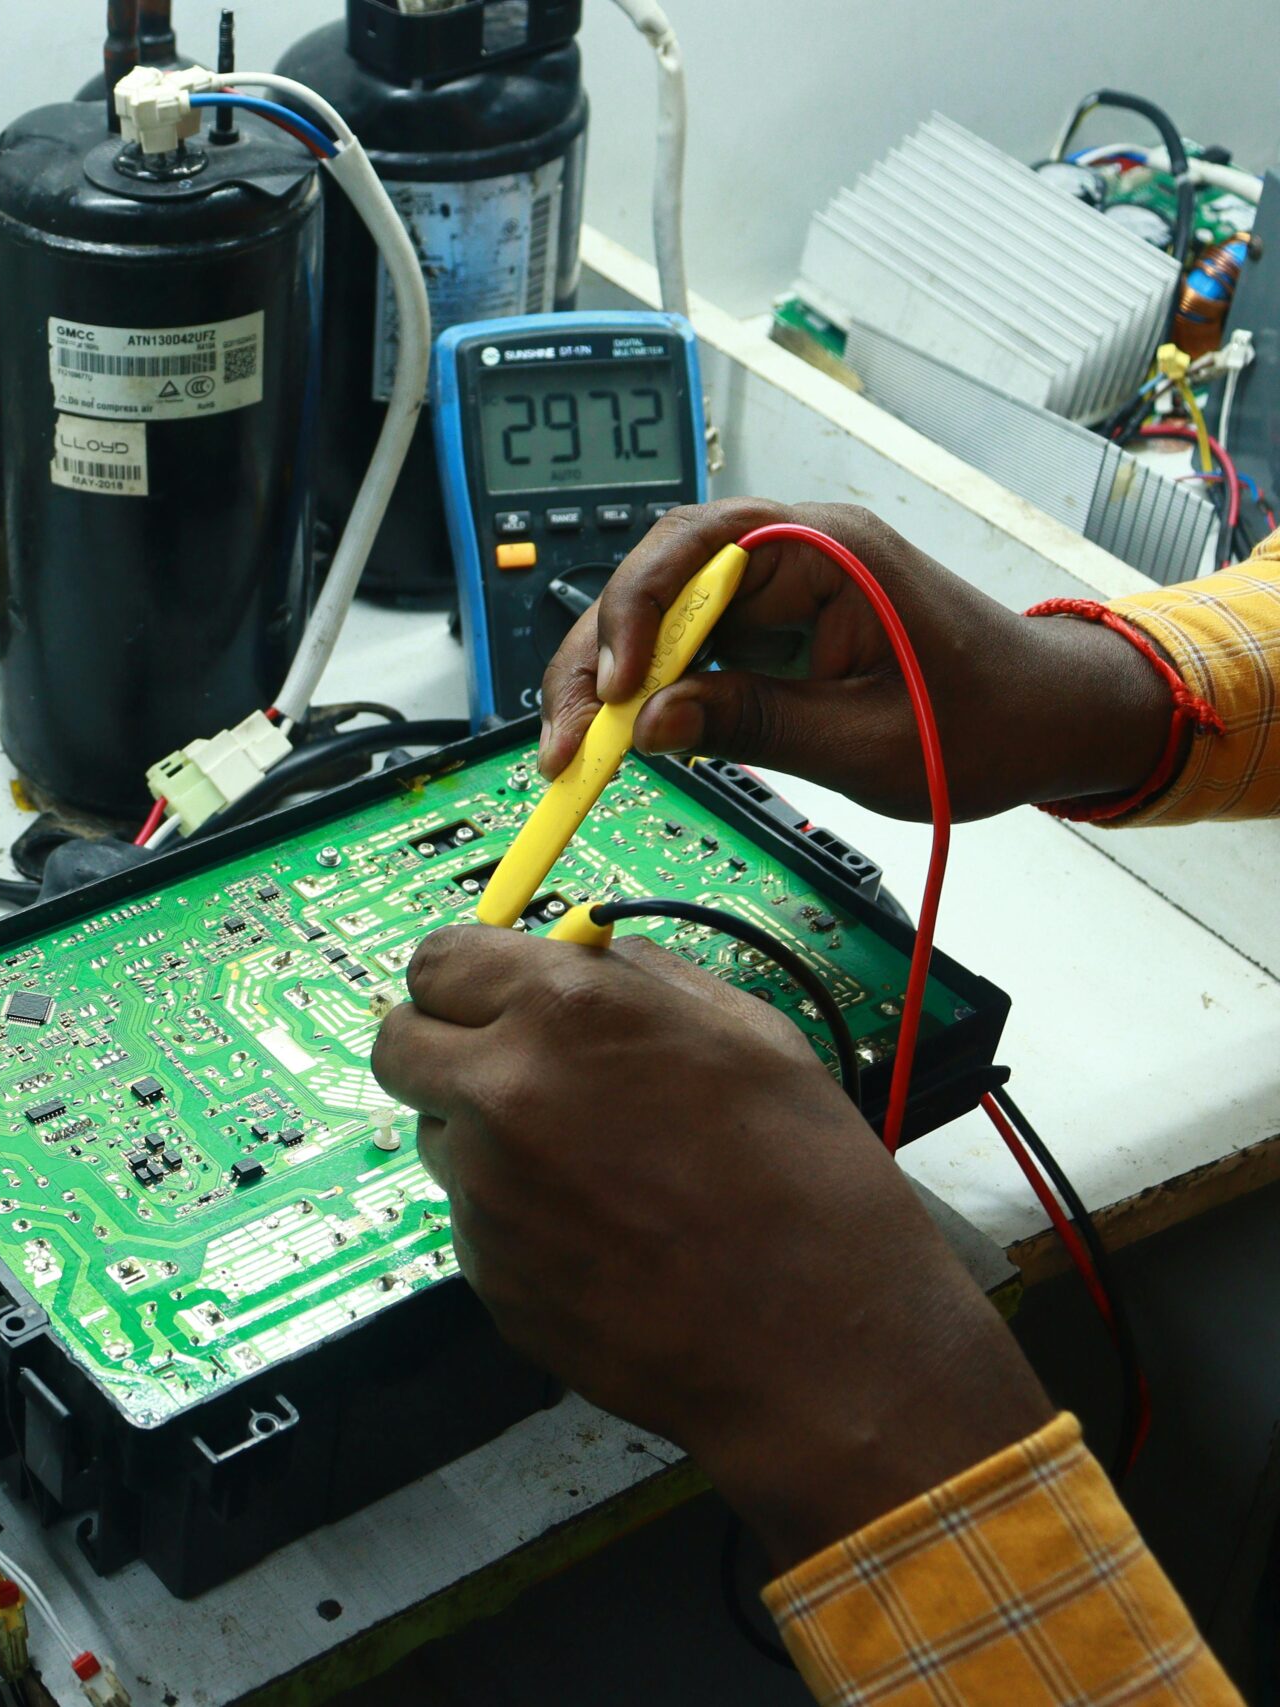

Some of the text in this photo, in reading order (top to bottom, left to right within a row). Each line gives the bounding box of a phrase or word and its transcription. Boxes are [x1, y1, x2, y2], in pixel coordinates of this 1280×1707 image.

[57, 326, 95, 341] GMCC
[127, 330, 216, 346] ATN130D42UFZ
[612, 338, 644, 347] DIGITAL
[504, 347, 555, 361] SUNSHINE
[612, 346, 664, 357] MULTIMETER
[81, 397, 95, 408] not
[96, 402, 138, 413] compress
[141, 404, 153, 412] air
[502, 387, 663, 466] 297.2
[60, 434, 129, 454] LLOYD
[72, 475, 123, 490] MAY-2018
[502, 521, 526, 531] HOLD
[551, 514, 579, 524] RANGE
